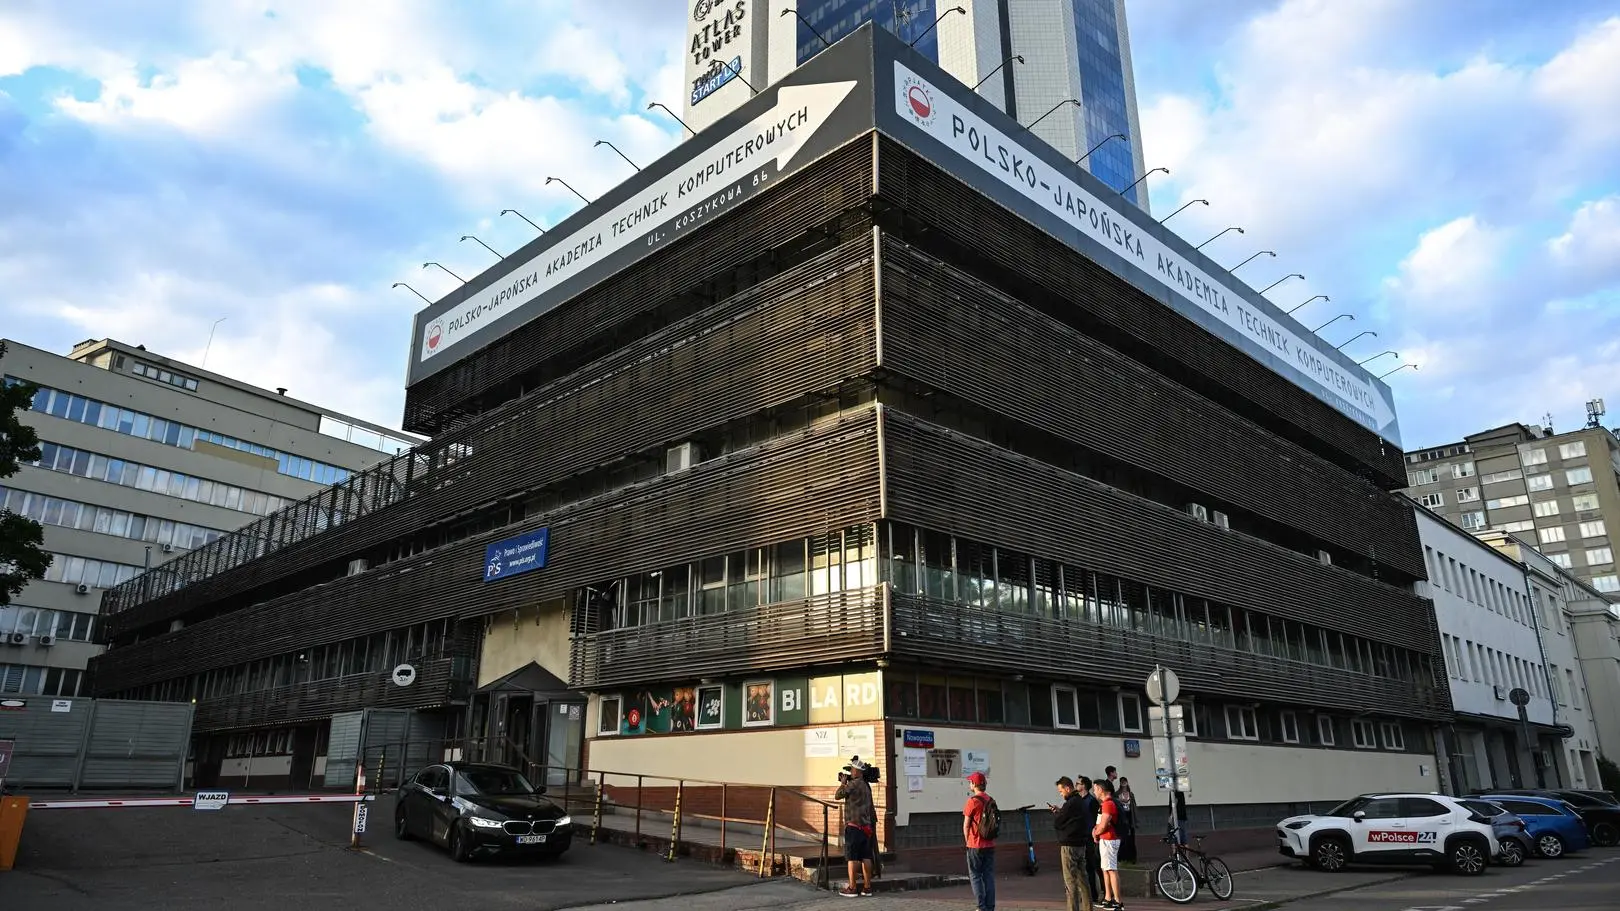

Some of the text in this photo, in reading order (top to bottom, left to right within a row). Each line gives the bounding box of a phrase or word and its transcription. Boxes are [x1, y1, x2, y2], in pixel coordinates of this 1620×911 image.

[691, 1, 745, 53] ATLAS
[694, 24, 741, 65] TOWER
[692, 59, 740, 103] START UP
[448, 106, 808, 334] POLSKO-JAPOŃSKA AKADEMIA TECHNIK KOMPUTEROWYCH
[647, 232, 666, 246] UL.
[675, 185, 742, 231] KOSZYKOWA
[953, 114, 1145, 261] POLSKO-JAPOŃSKA
[1157, 252, 1229, 316] AKADEMIA
[1237, 305, 1290, 355] TECHNIK
[1296, 346, 1375, 411] KOMPUTEROWYCH
[1371, 832, 1415, 842] wPolsce
